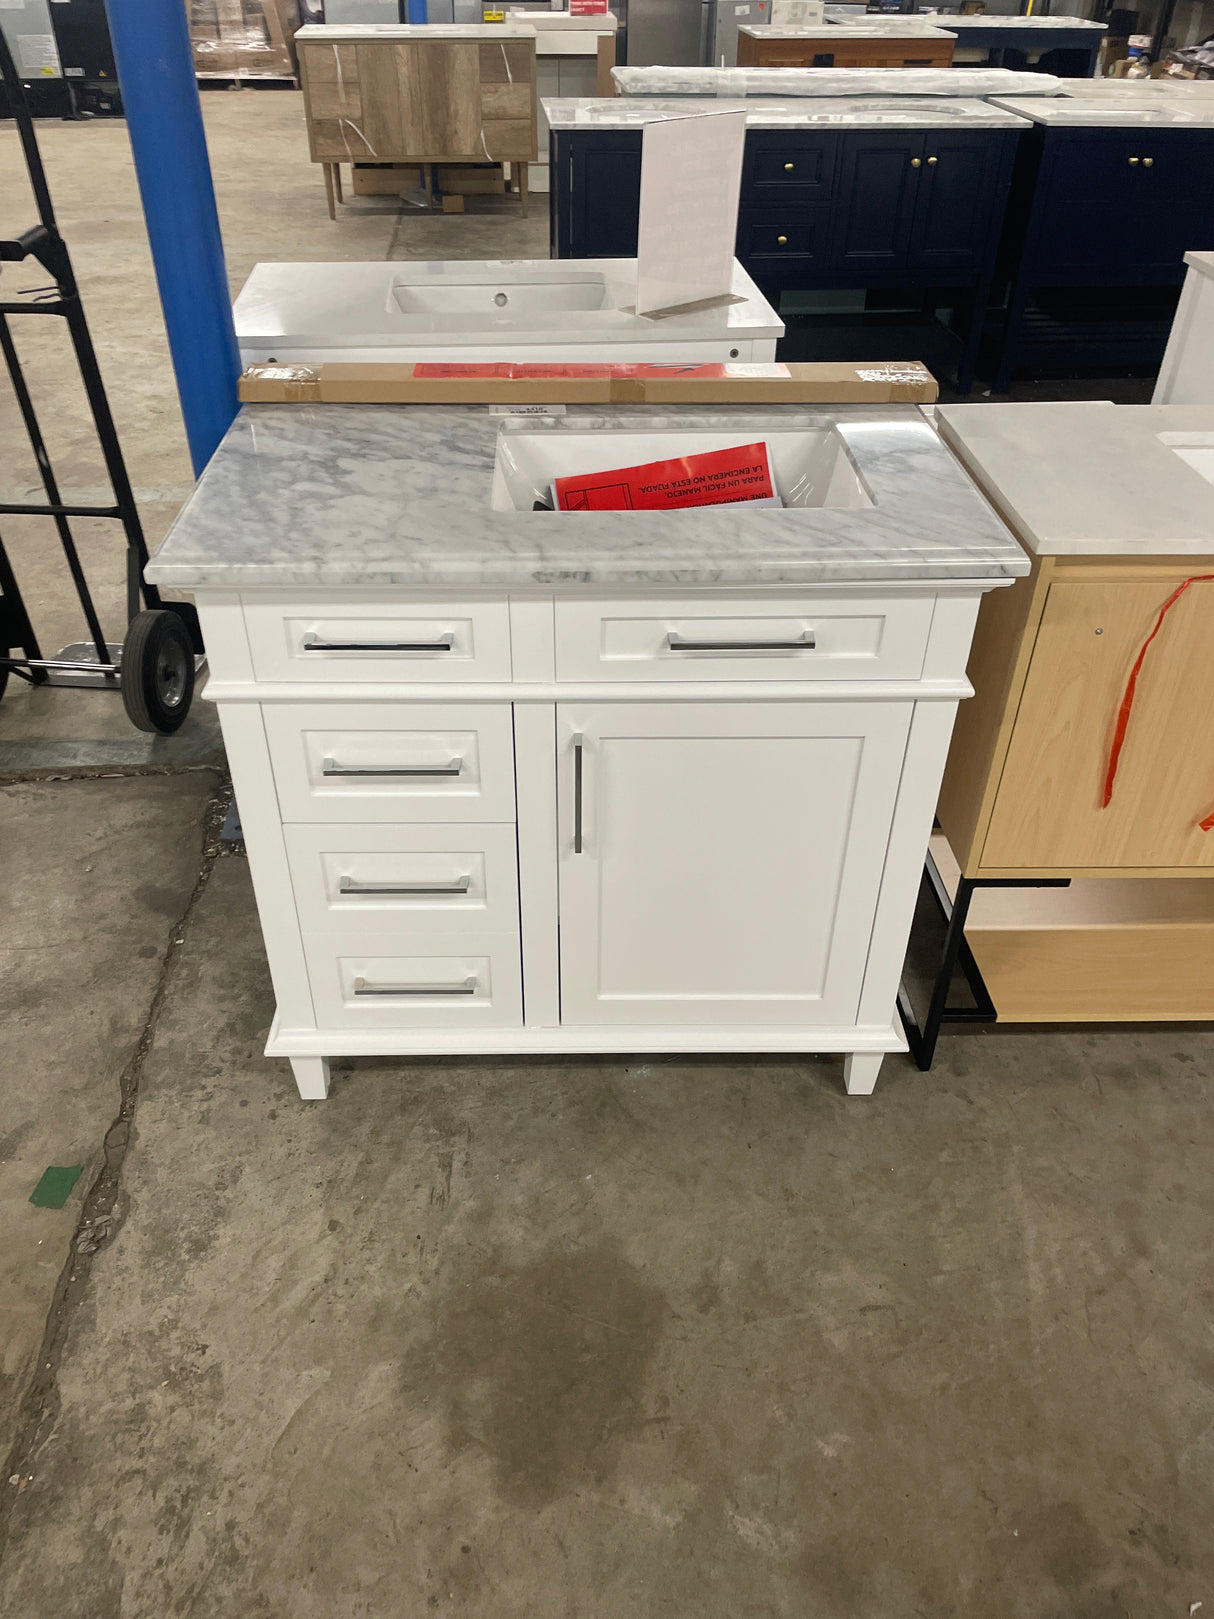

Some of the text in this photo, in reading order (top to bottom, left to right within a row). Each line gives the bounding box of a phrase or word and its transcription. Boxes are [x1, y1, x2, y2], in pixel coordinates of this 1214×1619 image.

[752, 465, 763, 473] LA
[708, 468, 750, 481] ENCIMERA
[693, 476, 706, 484] NO
[742, 475, 764, 485] PARA
[704, 482, 726, 492] FÁCIL
